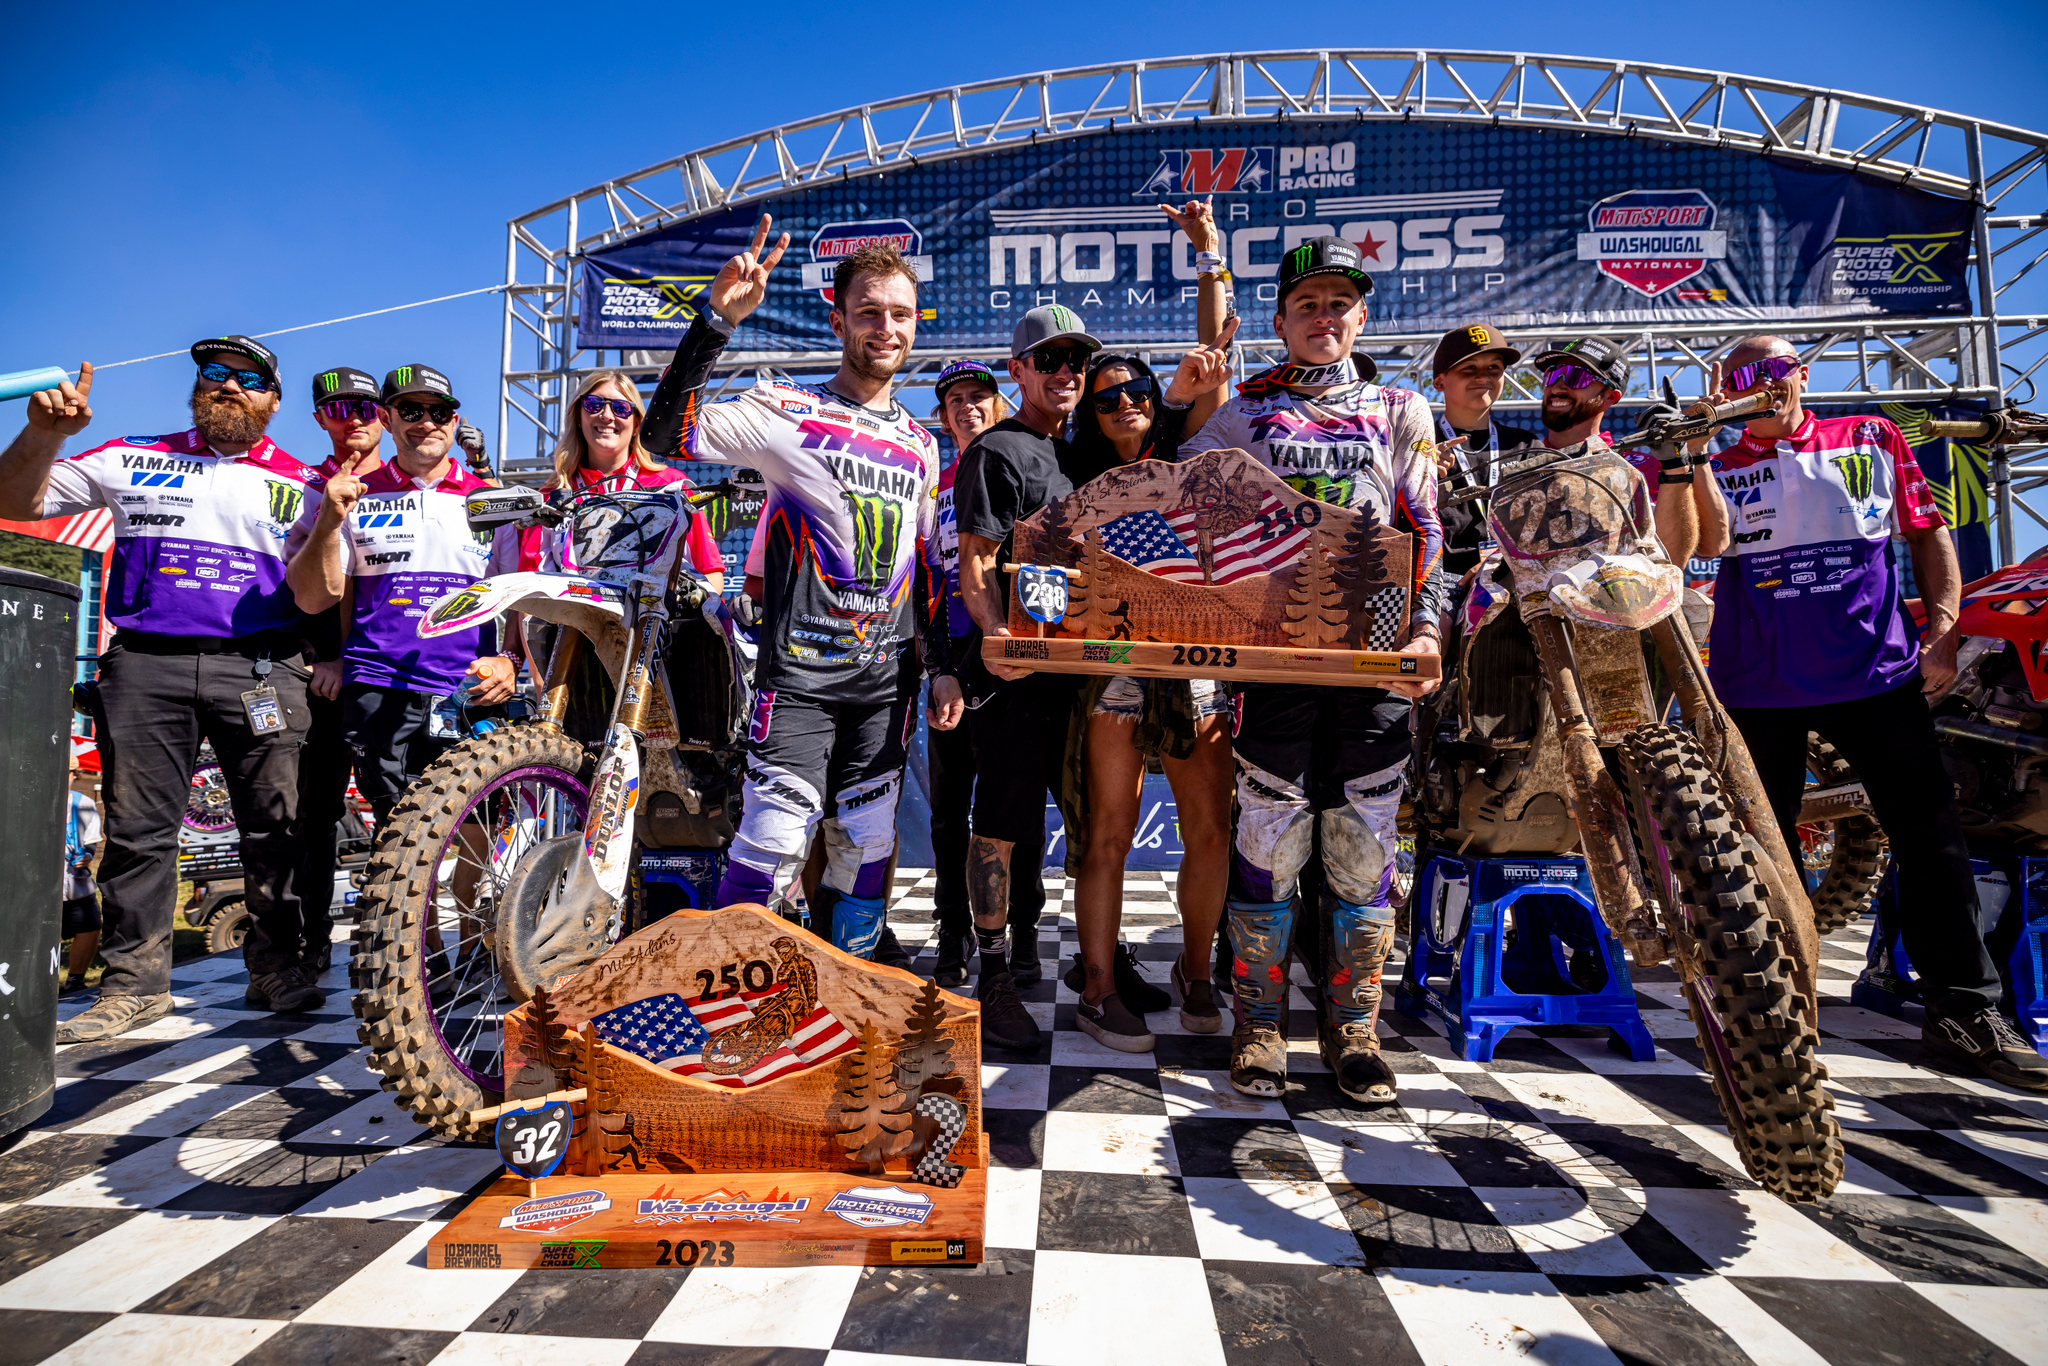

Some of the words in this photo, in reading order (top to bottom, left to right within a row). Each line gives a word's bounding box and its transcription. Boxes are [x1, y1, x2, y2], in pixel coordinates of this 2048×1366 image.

[1279, 141, 1356, 173] PRO
[1132, 146, 1274, 197] AMA
[1279, 171, 1356, 191] RACING
[1599, 236, 1704, 254] WASHOUGAL
[1336, 246, 1357, 259] YAMAHA
[1832, 246, 1896, 258] SUPER
[1610, 260, 1693, 270] NATIONAL
[1836, 257, 1893, 270] MOTO
[1832, 269, 1894, 282] CROSS
[602, 286, 662, 298] SUPER
[1832, 287, 1869, 296] WORLD
[1870, 284, 1953, 295] CHAMPIONSHIP
[604, 296, 661, 307] MOTO
[601, 305, 661, 317] CROSS
[601, 320, 635, 330] WORLD
[1590, 340, 1612, 354] YAMAHA
[946, 373, 975, 385] YAMAHA
[783, 401, 810, 414] 100%
[857, 417, 880, 429] OPTIMA
[1268, 443, 1375, 471] YAMAHA
[121, 454, 204, 476] YAMAHA
[825, 455, 916, 502] YAMAHA
[1099, 486, 1113, 500] St
[1115, 474, 1148, 495] Helens
[166, 494, 194, 504] YAMAHA
[352, 498, 416, 514] AMAHA
[482, 500, 516, 512] CYCRA
[1751, 507, 1777, 518] YAMAHA
[128, 513, 186, 527] THOR
[1254, 500, 1322, 542] 250
[578, 505, 679, 567] 32
[166, 542, 190, 550] YAMAHA
[1801, 544, 1853, 556] BICYCLES
[210, 547, 256, 560] BICYCLES
[364, 551, 412, 566] THOR
[1757, 554, 1781, 563] YAMAHA
[198, 568, 218, 577] 100%
[1795, 574, 1814, 583] 100%
[429, 576, 468, 585] BICYCLES
[1024, 582, 1066, 612] 238
[1773, 589, 1801, 598] ESCONDIDO
[810, 615, 839, 628] YAMAHA
[1171, 645, 1238, 668] 2023
[1294, 653, 1324, 662] Vancouver
[1360, 659, 1397, 668] PETERSON
[1401, 660, 1416, 670] CAT
[253, 704, 273, 712] CREW
[688, 737, 701, 745] Twin
[845, 781, 891, 810] THOR
[593, 756, 624, 863] DUNLOP
[618, 786, 632, 829] BRAKING
[1503, 868, 1578, 878] MOTOCROSS
[630, 933, 677, 966] Adams
[695, 959, 774, 1002] 250
[511, 1120, 562, 1165] 32
[516, 1204, 595, 1223] WASHOUGAL
[638, 1198, 811, 1216] Washougal
[830, 1204, 923, 1219] CHAMPIONSHIP
[833, 1199, 927, 1216] MOTOCROSS
[523, 1213, 585, 1228] NATIONAL
[541, 1246, 576, 1254] SUPER
[655, 1239, 736, 1268] 2023
[819, 1243, 856, 1252] Vancouver
[900, 1246, 943, 1255] PETERSON
[948, 1243, 965, 1256] CAT
